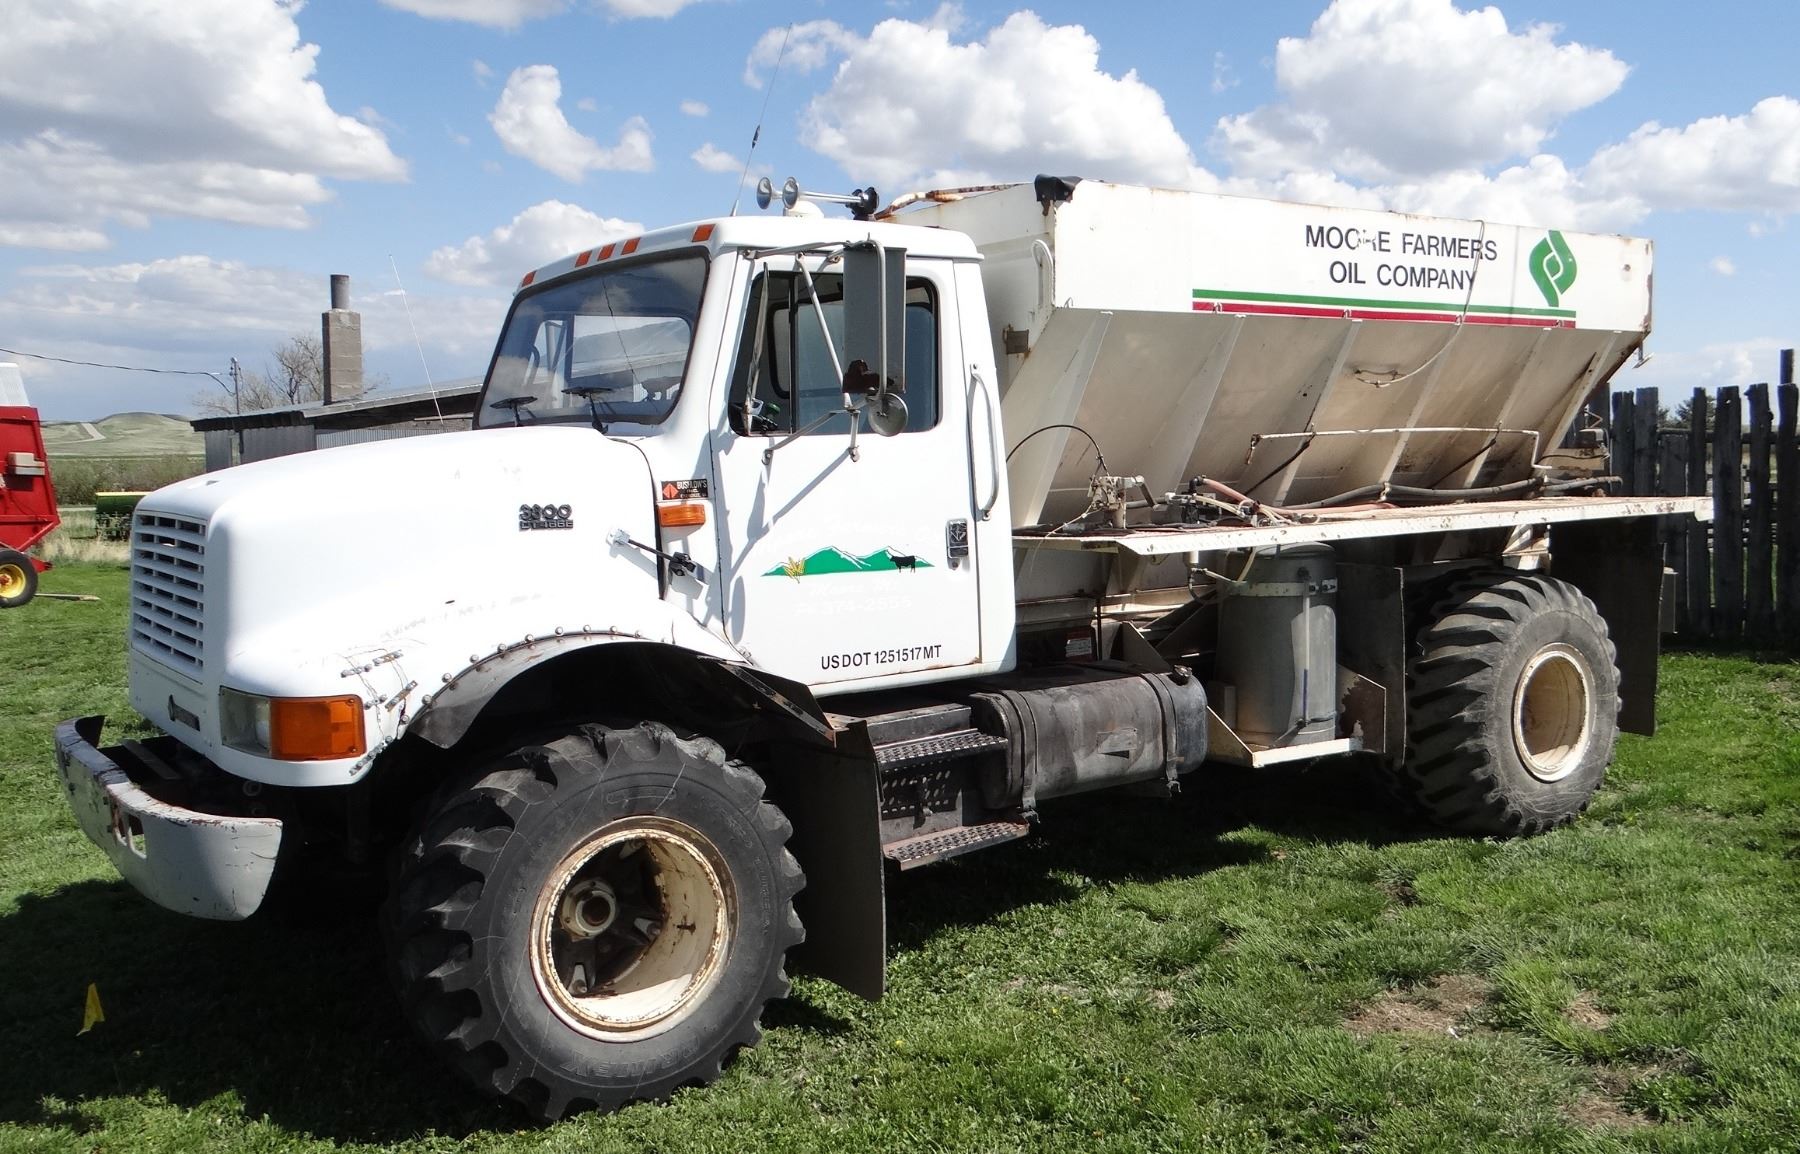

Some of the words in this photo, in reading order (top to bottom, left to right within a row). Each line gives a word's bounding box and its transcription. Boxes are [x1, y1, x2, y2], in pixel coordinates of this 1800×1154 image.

[1305, 224, 1391, 252] MOOE
[1402, 232, 1498, 261] FARMERS
[1329, 260, 1366, 284] OIL
[1376, 263, 1478, 290] COMPANY
